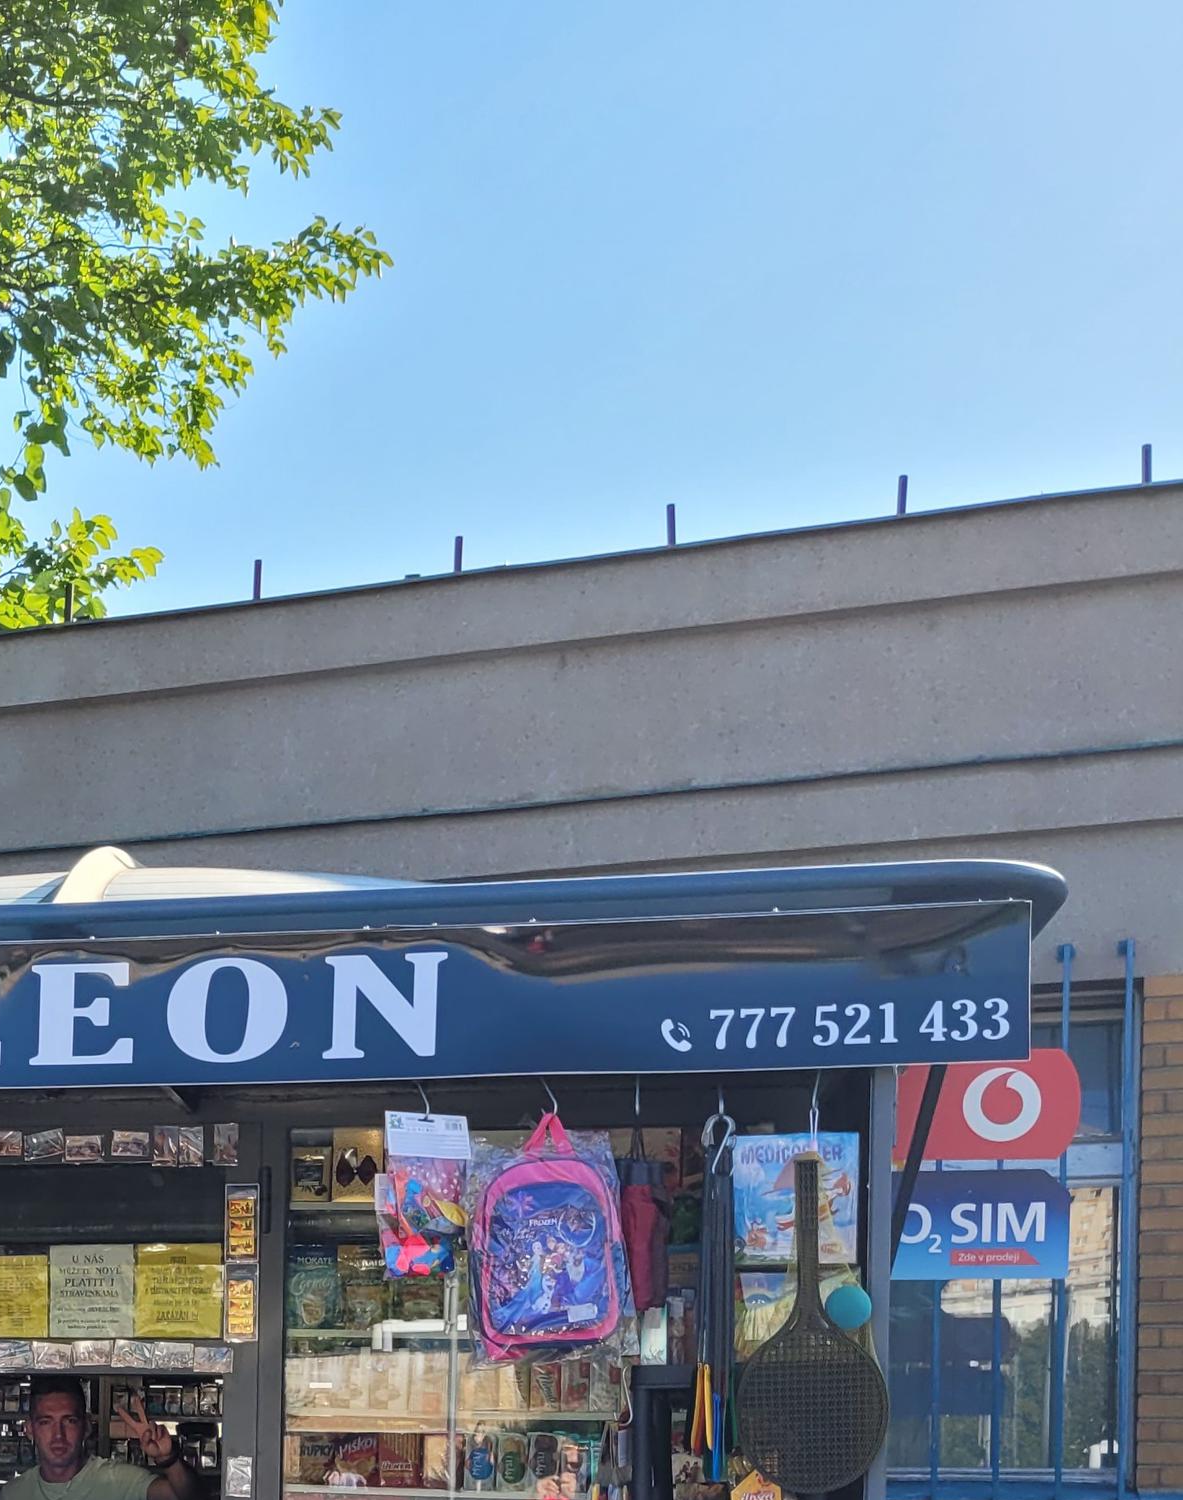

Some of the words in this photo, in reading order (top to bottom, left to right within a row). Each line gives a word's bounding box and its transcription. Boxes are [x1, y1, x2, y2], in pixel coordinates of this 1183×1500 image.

[709, 1006, 796, 1050] 777
[813, 1002, 899, 1047] 521
[919, 998, 1010, 1043] 433
[950, 1201, 1047, 1245] SIM
[958, 1253, 975, 1263] Zde
[977, 1254, 985, 1263] v
[986, 1252, 1020, 1265] prodeji
